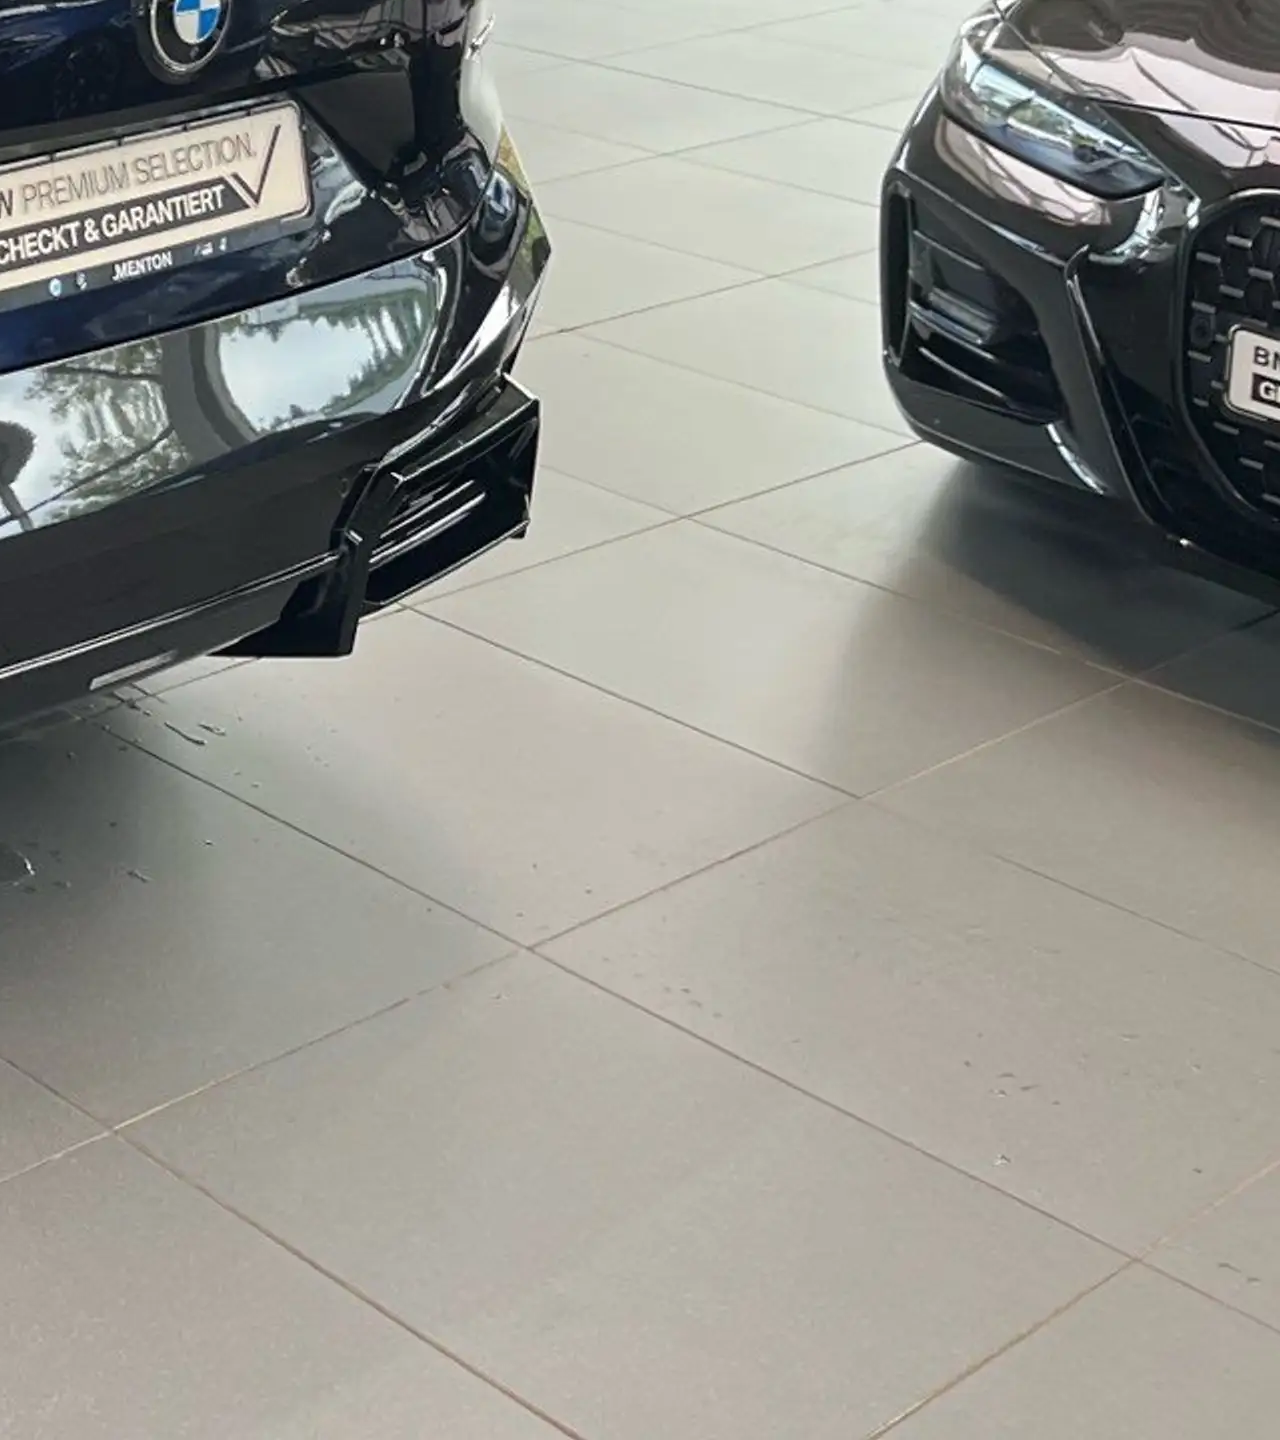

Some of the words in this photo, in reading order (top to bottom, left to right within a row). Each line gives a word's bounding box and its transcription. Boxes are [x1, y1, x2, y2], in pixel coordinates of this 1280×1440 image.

[21, 162, 130, 214] PREMIUM
[83, 217, 102, 243] &
[101, 183, 227, 239] GARANTIERT
[112, 251, 173, 282] MENTON
